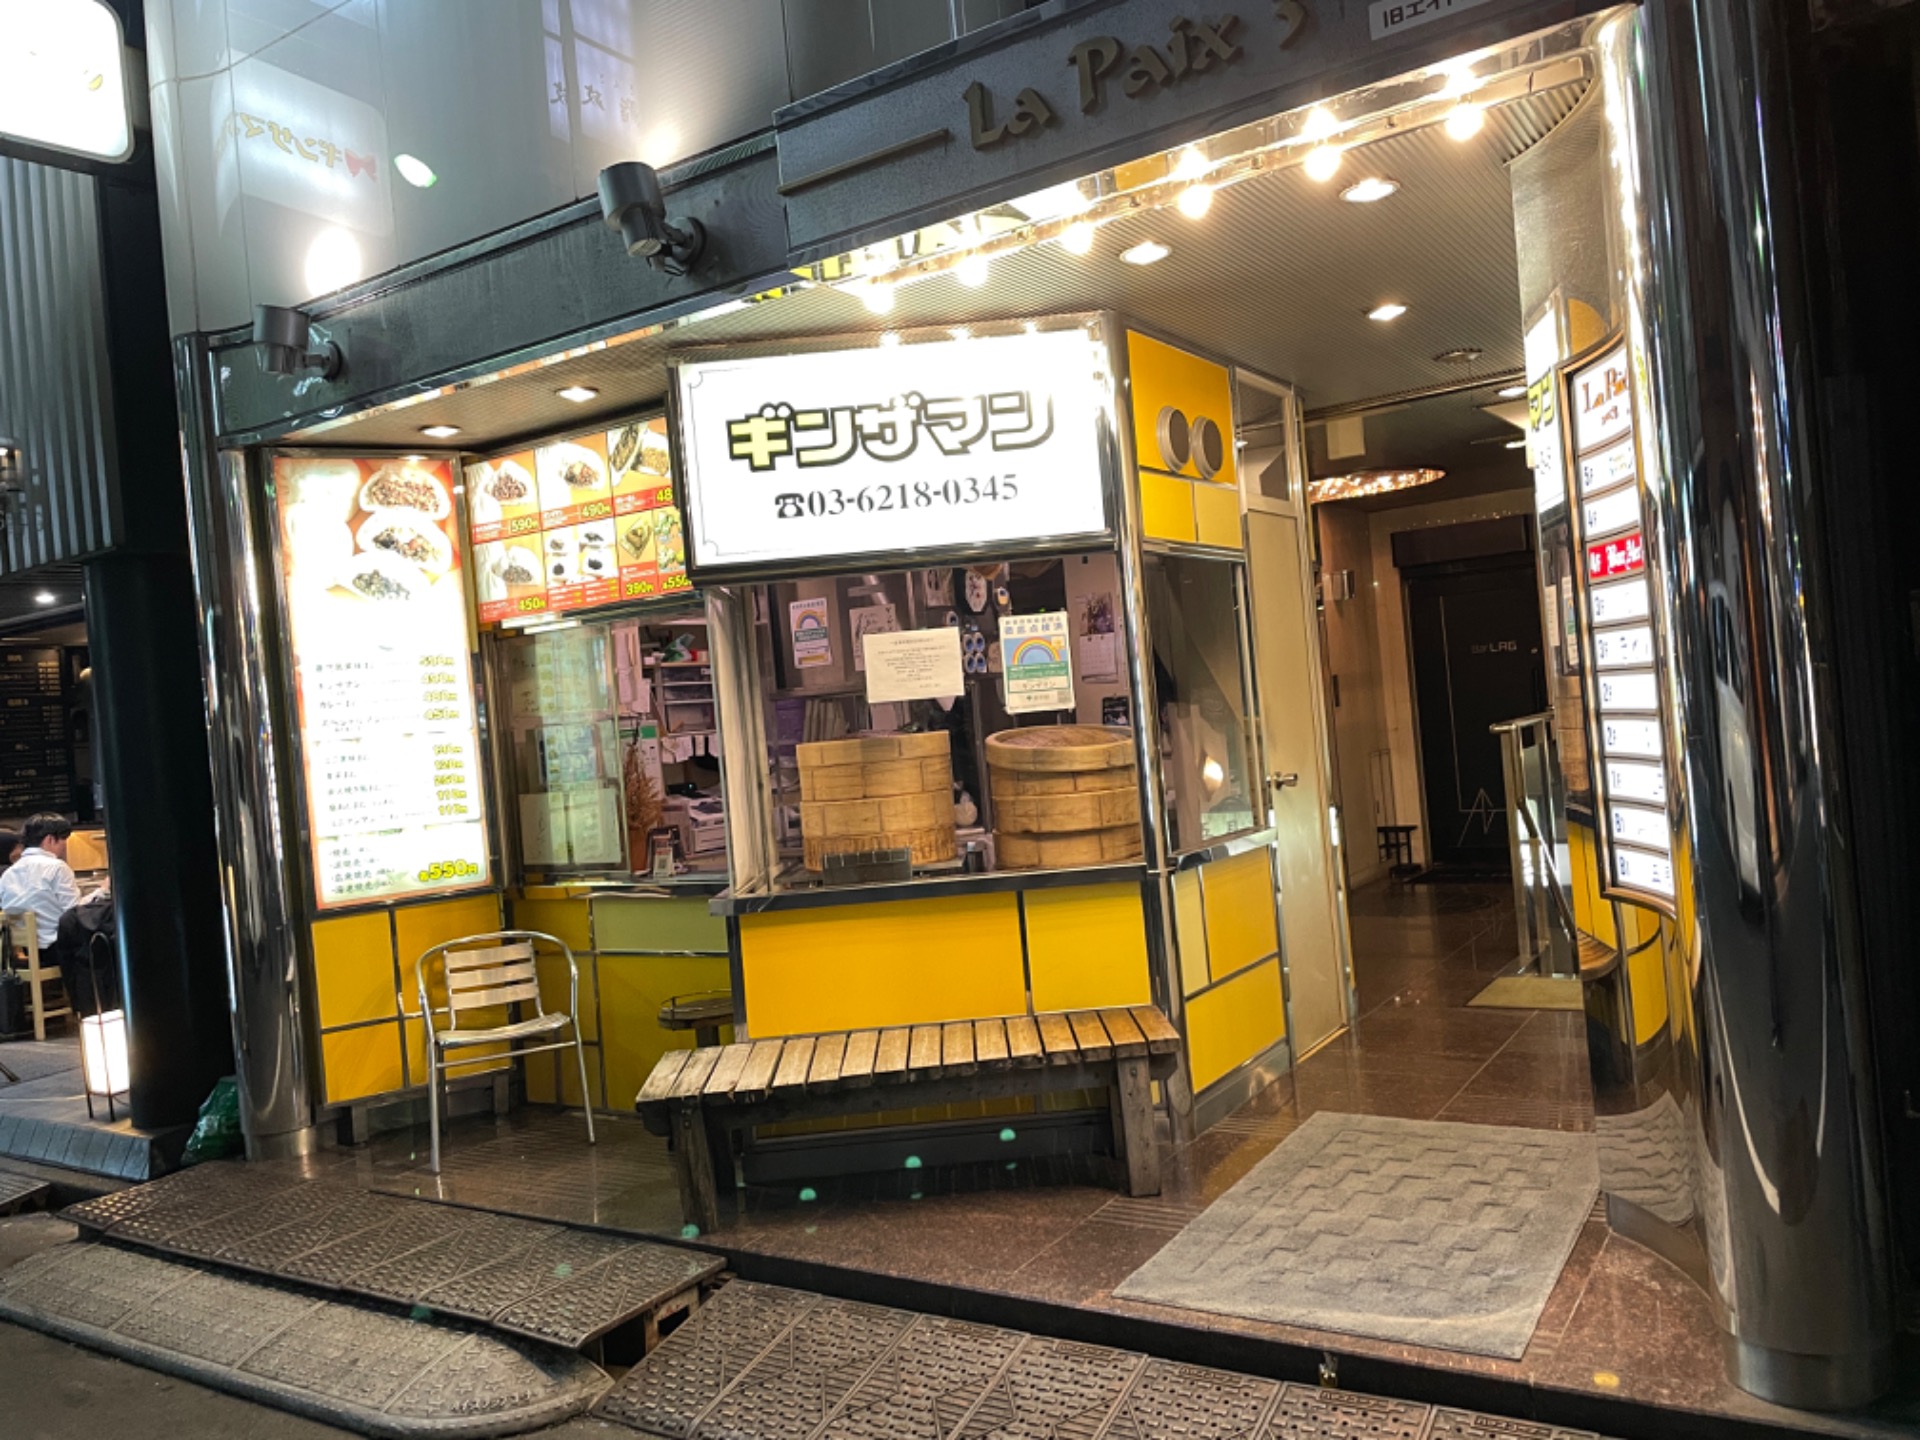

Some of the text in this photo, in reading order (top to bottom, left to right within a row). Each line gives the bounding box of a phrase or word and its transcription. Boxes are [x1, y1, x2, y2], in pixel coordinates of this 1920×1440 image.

[1382, 0, 1453, 28] 旧エイ
[963, 80, 1053, 150] La
[1069, 12, 1243, 114] Paix
[725, 389, 1055, 472] ギンザマン
[808, 473, 1019, 517] 03-6218-0345
